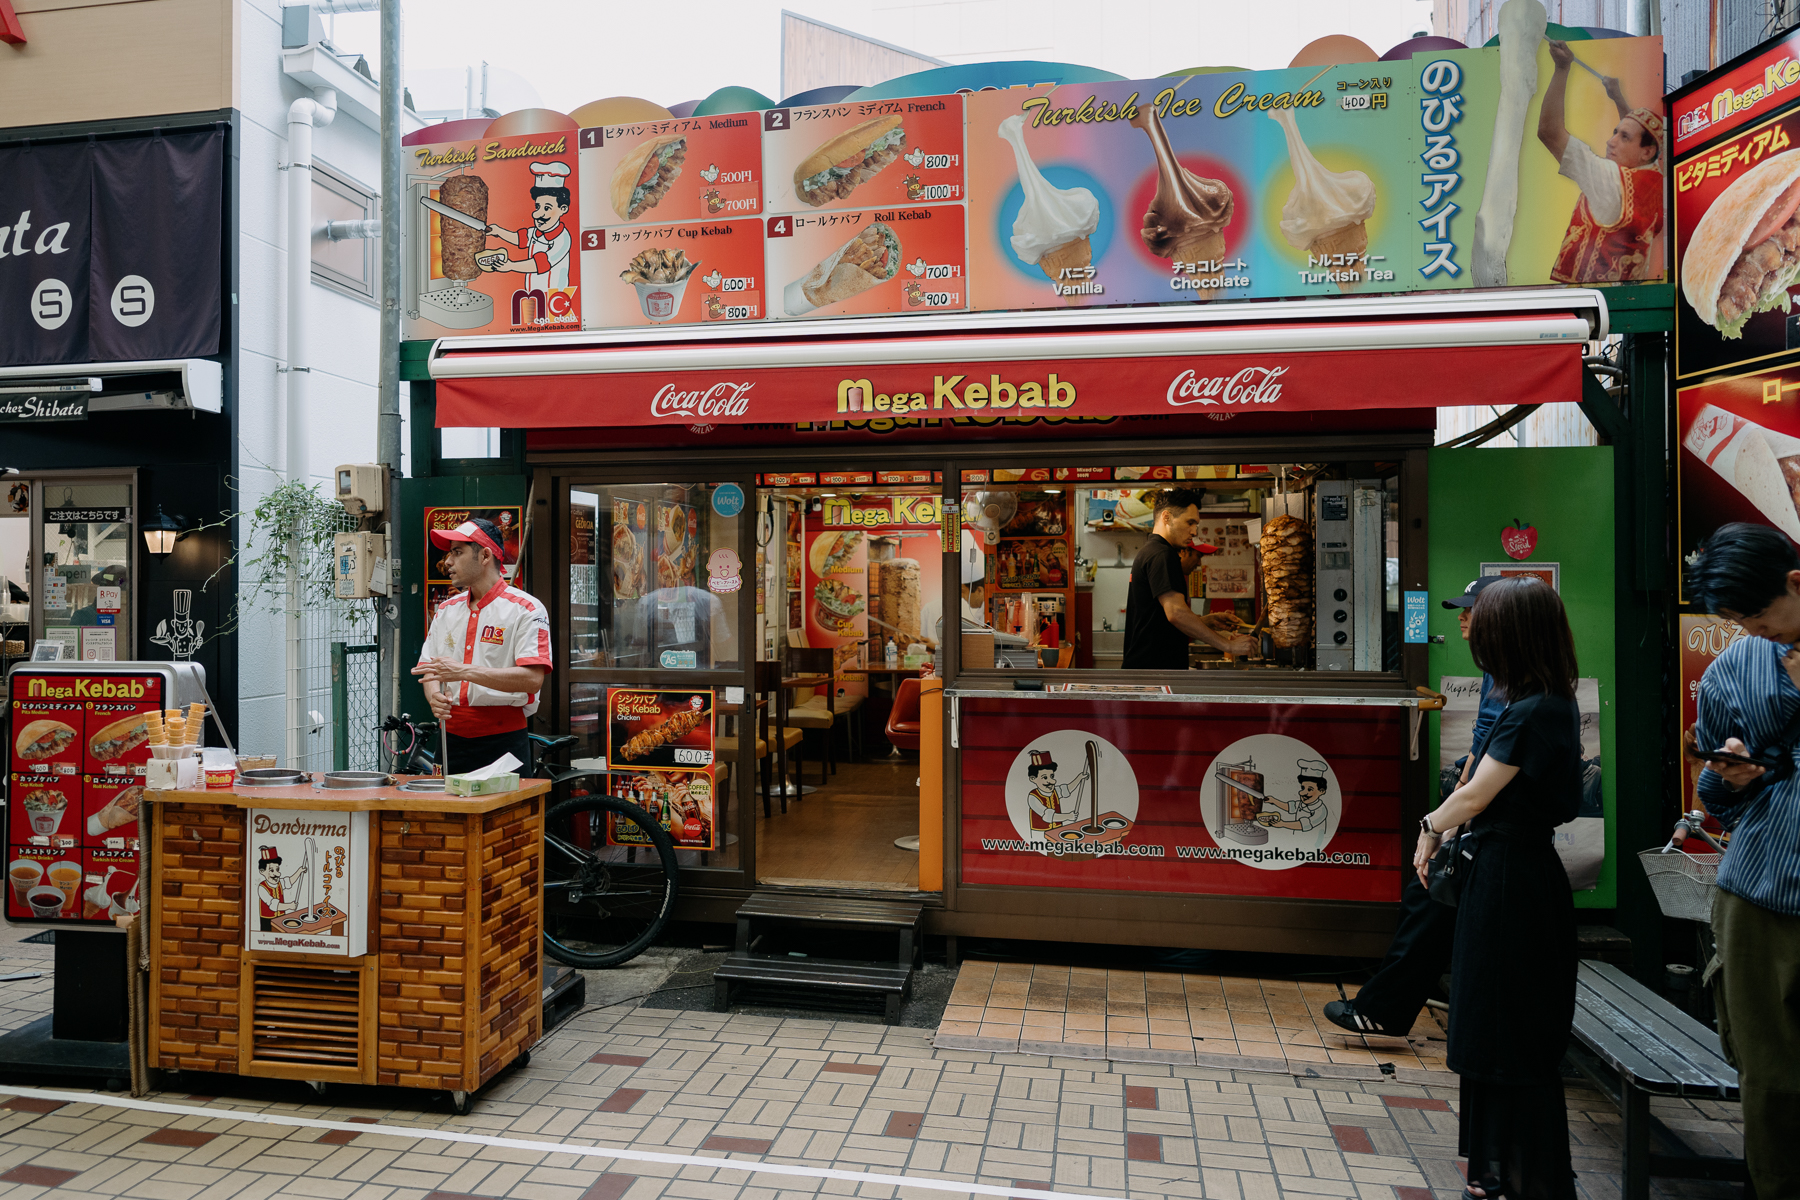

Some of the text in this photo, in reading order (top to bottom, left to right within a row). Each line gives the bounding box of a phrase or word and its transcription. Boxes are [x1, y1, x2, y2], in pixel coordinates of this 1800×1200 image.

[1337, 77, 1392, 91] コーン入り
[1711, 50, 1800, 125] Mega Ke
[907, 100, 946, 113] French
[1021, 82, 1325, 128] Turkish Ice Cream
[708, 117, 749, 130] Medium
[771, 112, 783, 128] 2
[587, 131, 595, 144] 1
[415, 135, 567, 168] Turkish Sandwich
[1678, 123, 1791, 193] ピタミディアム
[925, 154, 959, 168] 800円
[1419, 58, 1463, 279] のびるアイス
[720, 170, 752, 183] 500円
[925, 185, 960, 200] 1000円
[726, 198, 757, 211] 700円
[795, 209, 932, 228] ロールケバブ Roll Kebab
[0, 209, 71, 258] ta
[611, 224, 733, 243] カップケバブ Cup Kebab
[774, 220, 786, 234] 4
[588, 234, 598, 248] 3
[1171, 258, 1248, 274] チョコレート
[1308, 252, 1386, 267] トルコティー
[925, 264, 961, 279] 700円
[1058, 266, 1097, 280] バニラ
[1298, 267, 1394, 284] Turkish Tea
[723, 276, 755, 291] 600円
[1052, 282, 1103, 296] Vanilla
[1170, 275, 1250, 291] Chocolate
[38, 288, 63, 319] S
[119, 285, 146, 316] S
[925, 292, 960, 306] 900円
[727, 304, 758, 319] 800円
[509, 324, 580, 333] www.MegaKebab.com
[837, 373, 1077, 414] Mega Kebab
[1166, 366, 1290, 407] Coca-Cola
[650, 381, 756, 418] Coca-Cola
[18, 397, 83, 418] Shibata
[690, 424, 715, 434] HALAL
[717, 496, 739, 505] Wolt
[49, 510, 120, 521] ご注文はこちらです
[433, 511, 470, 522] シシケバブ
[823, 497, 890, 527] Mega
[59, 568, 87, 583] open
[830, 565, 863, 574] Medium
[106, 590, 119, 599] Pay
[1407, 596, 1426, 604] Wolt
[836, 620, 854, 630] Cup
[837, 629, 864, 638] Kebab
[28, 678, 145, 699] Mega Kebab
[1468, 680, 1482, 698] Ke
[21, 702, 83, 711] ピタパンミディアム
[617, 694, 657, 704] シシケバブ
[94, 703, 137, 711] フランスパン
[632, 704, 661, 714] Kebab
[616, 714, 641, 722] Chicken
[19, 775, 60, 783] カップケバブ
[92, 777, 135, 785] ロールケバブ
[253, 814, 348, 838] Dondurma
[92, 850, 134, 858] トルコアイス
[981, 836, 1165, 857] www.megakebab.com
[1176, 842, 1371, 865] www.megakebab.com
[333, 845, 346, 878] のびる
[322, 850, 333, 918] トルコアイス
[257, 936, 340, 949] www.MegaKebab.com
